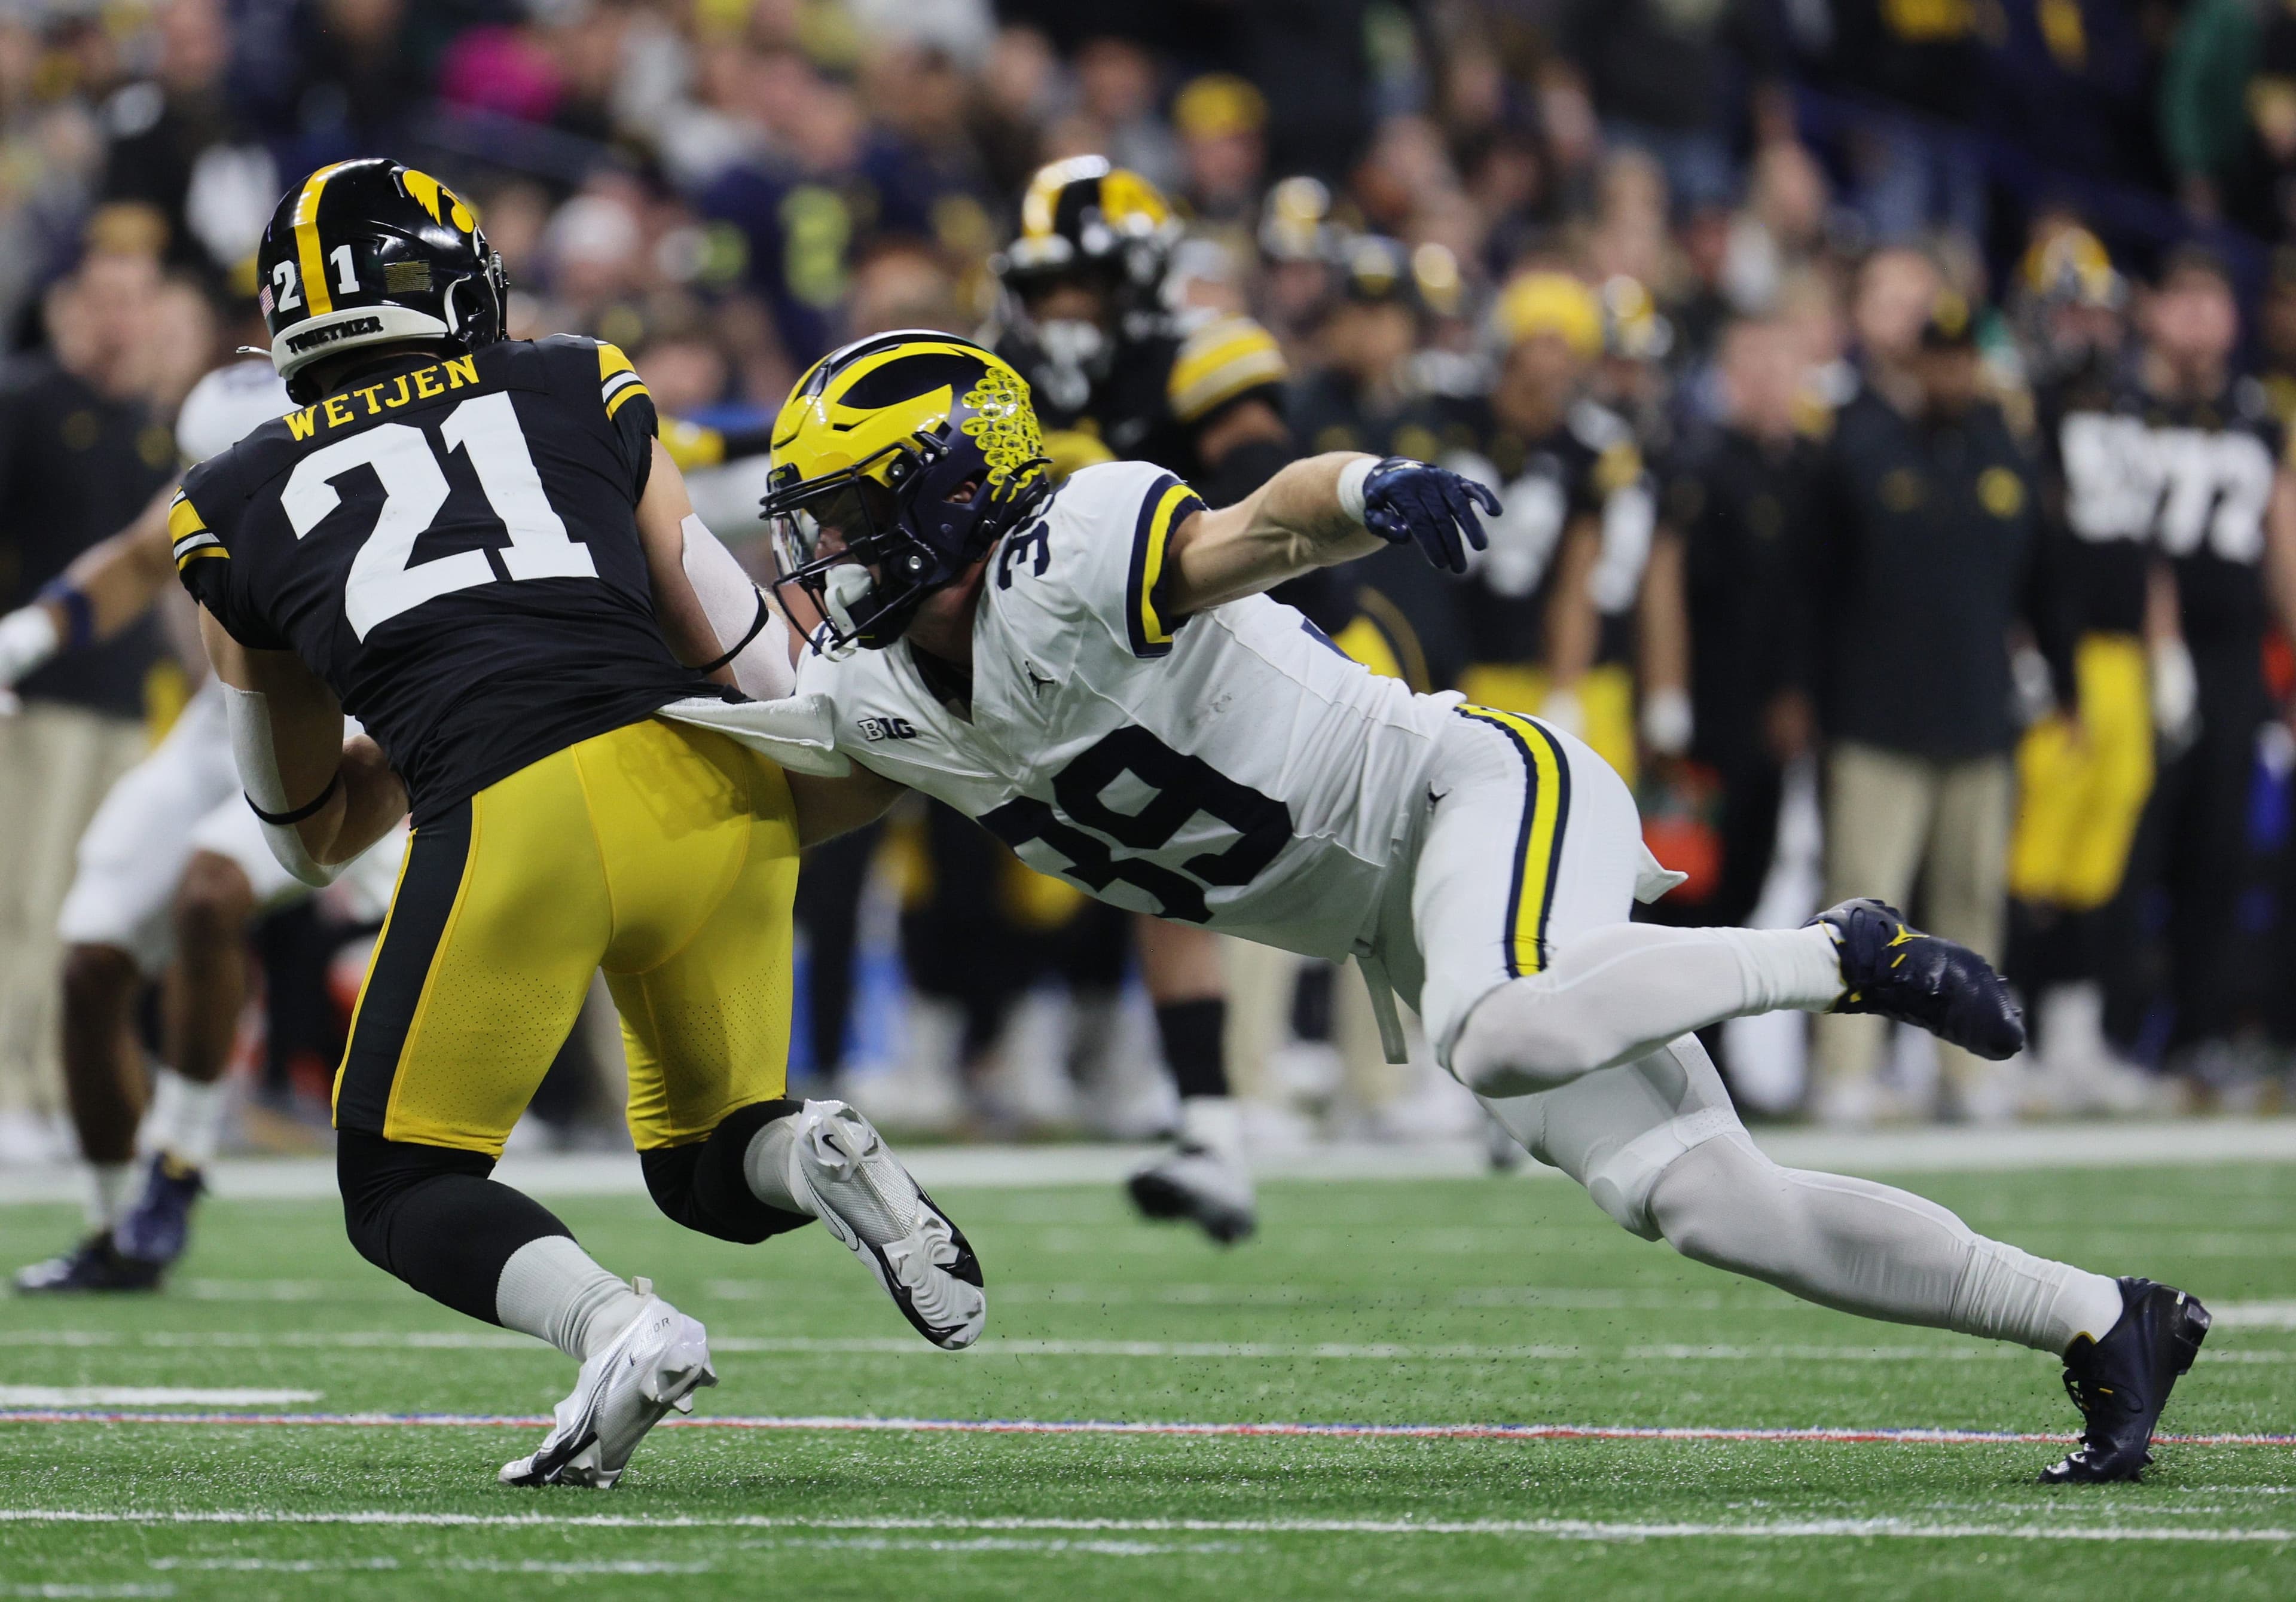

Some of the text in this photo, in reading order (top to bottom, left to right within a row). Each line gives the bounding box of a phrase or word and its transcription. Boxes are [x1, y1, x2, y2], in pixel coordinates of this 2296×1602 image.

[283, 354, 480, 441] WETJEN
[280, 390, 600, 644] 21
[976, 724, 1294, 924] 39
